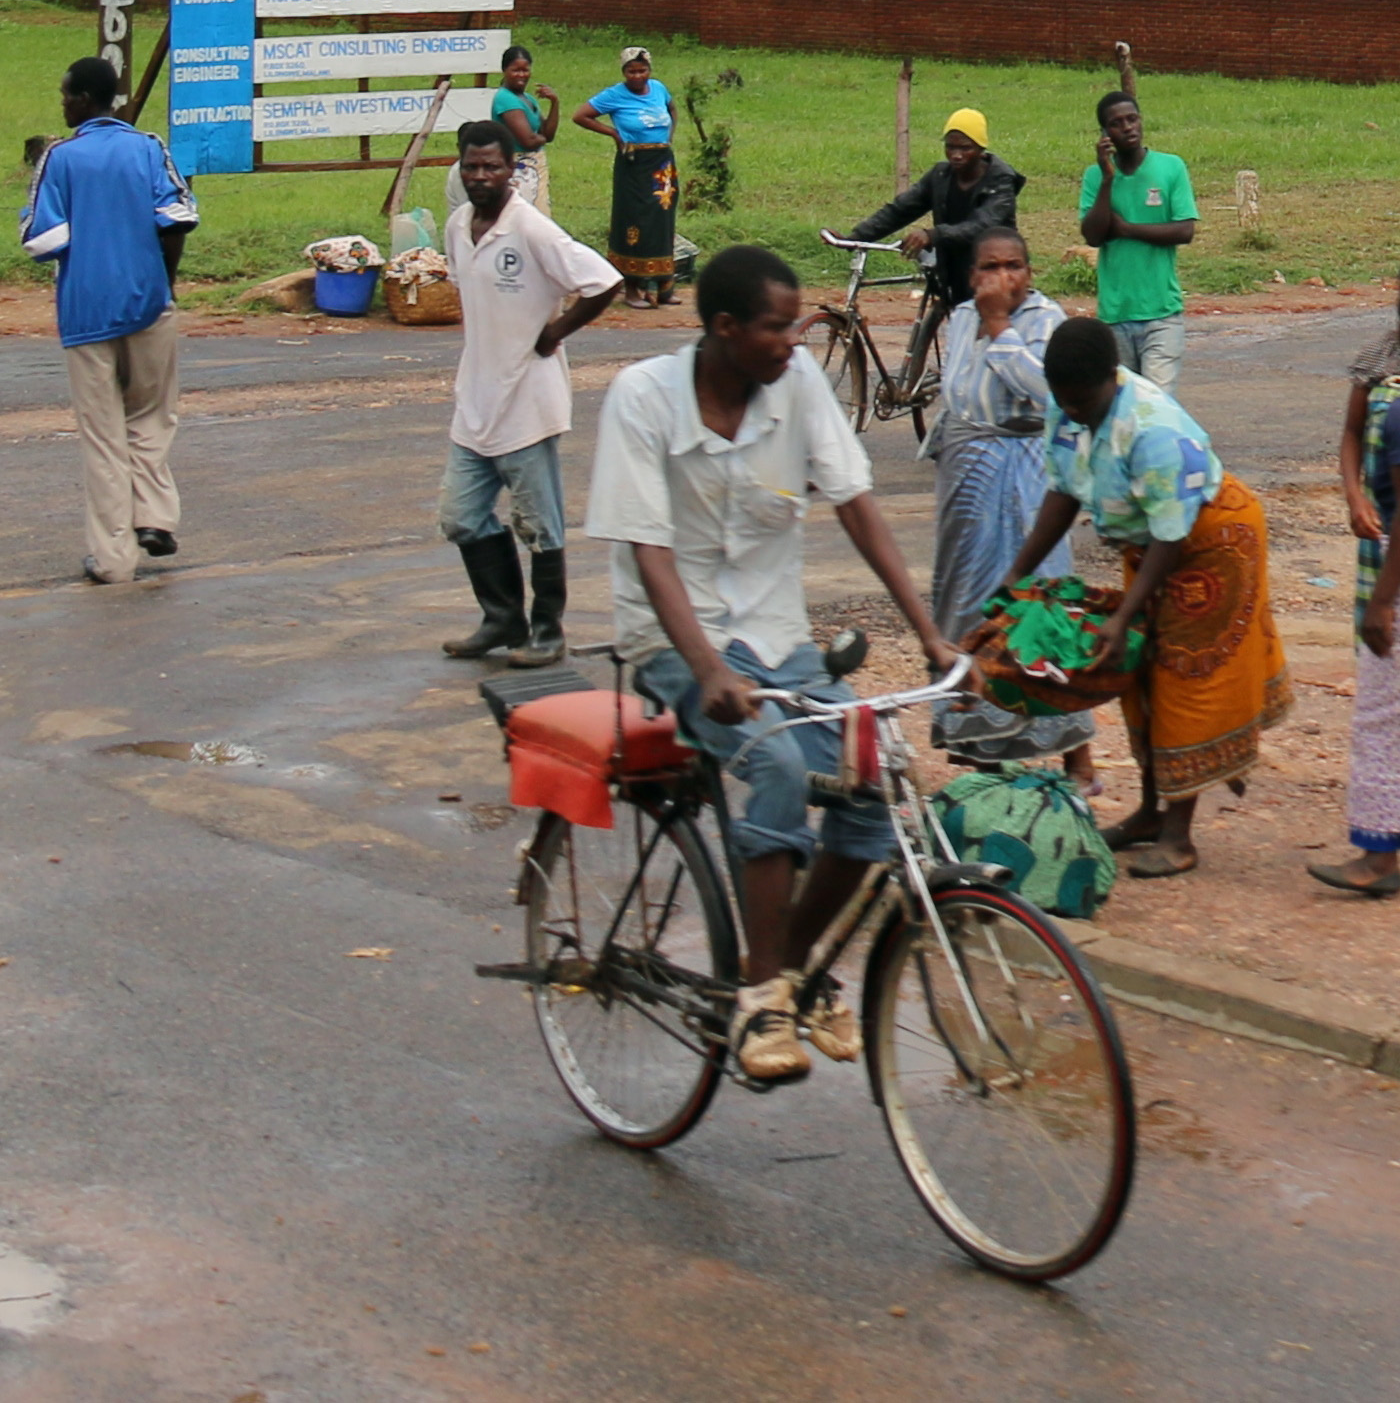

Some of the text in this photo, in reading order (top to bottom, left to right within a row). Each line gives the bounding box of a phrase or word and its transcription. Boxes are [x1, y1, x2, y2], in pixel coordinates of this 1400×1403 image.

[173, 45, 250, 64] CONSULTING
[263, 36, 487, 60] MSCAT CONSULTING ENGINEERS
[174, 65, 240, 83] ENGINEER
[173, 105, 252, 126] CONTRACTOR
[263, 101, 327, 120] SEMPHA
[504, 253, 517, 271] P
